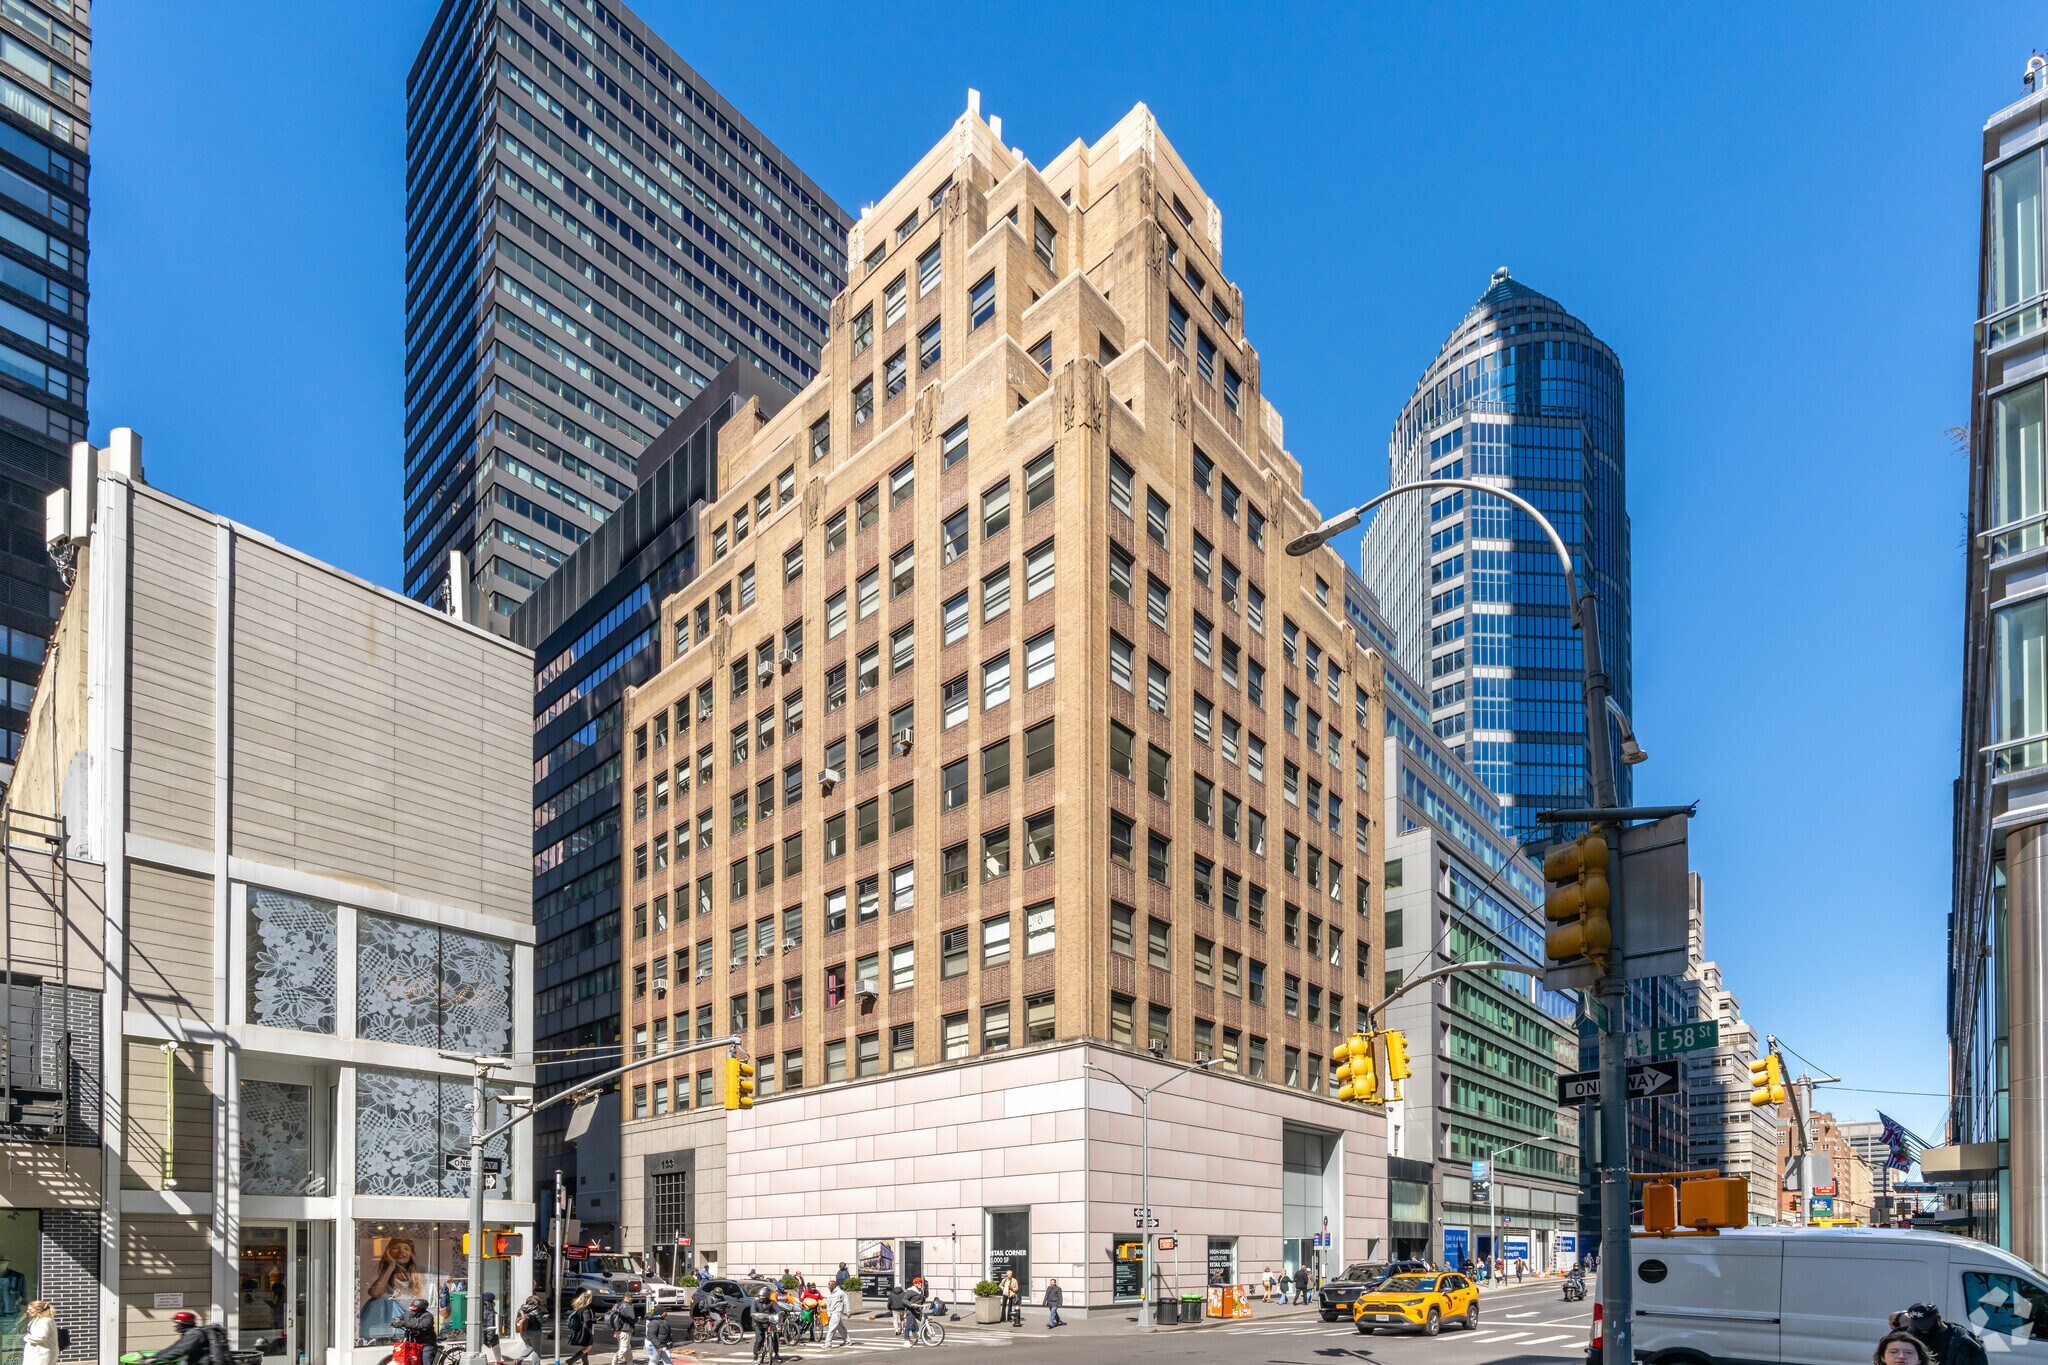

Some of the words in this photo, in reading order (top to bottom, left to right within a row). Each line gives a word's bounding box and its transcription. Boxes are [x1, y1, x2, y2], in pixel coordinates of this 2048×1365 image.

[1658, 1031, 1667, 1050] E
[1672, 1027, 1695, 1049] 58
[1699, 1025, 1711, 1038] St
[1575, 1080, 1600, 1096] ON
[661, 1159, 673, 1169] 133
